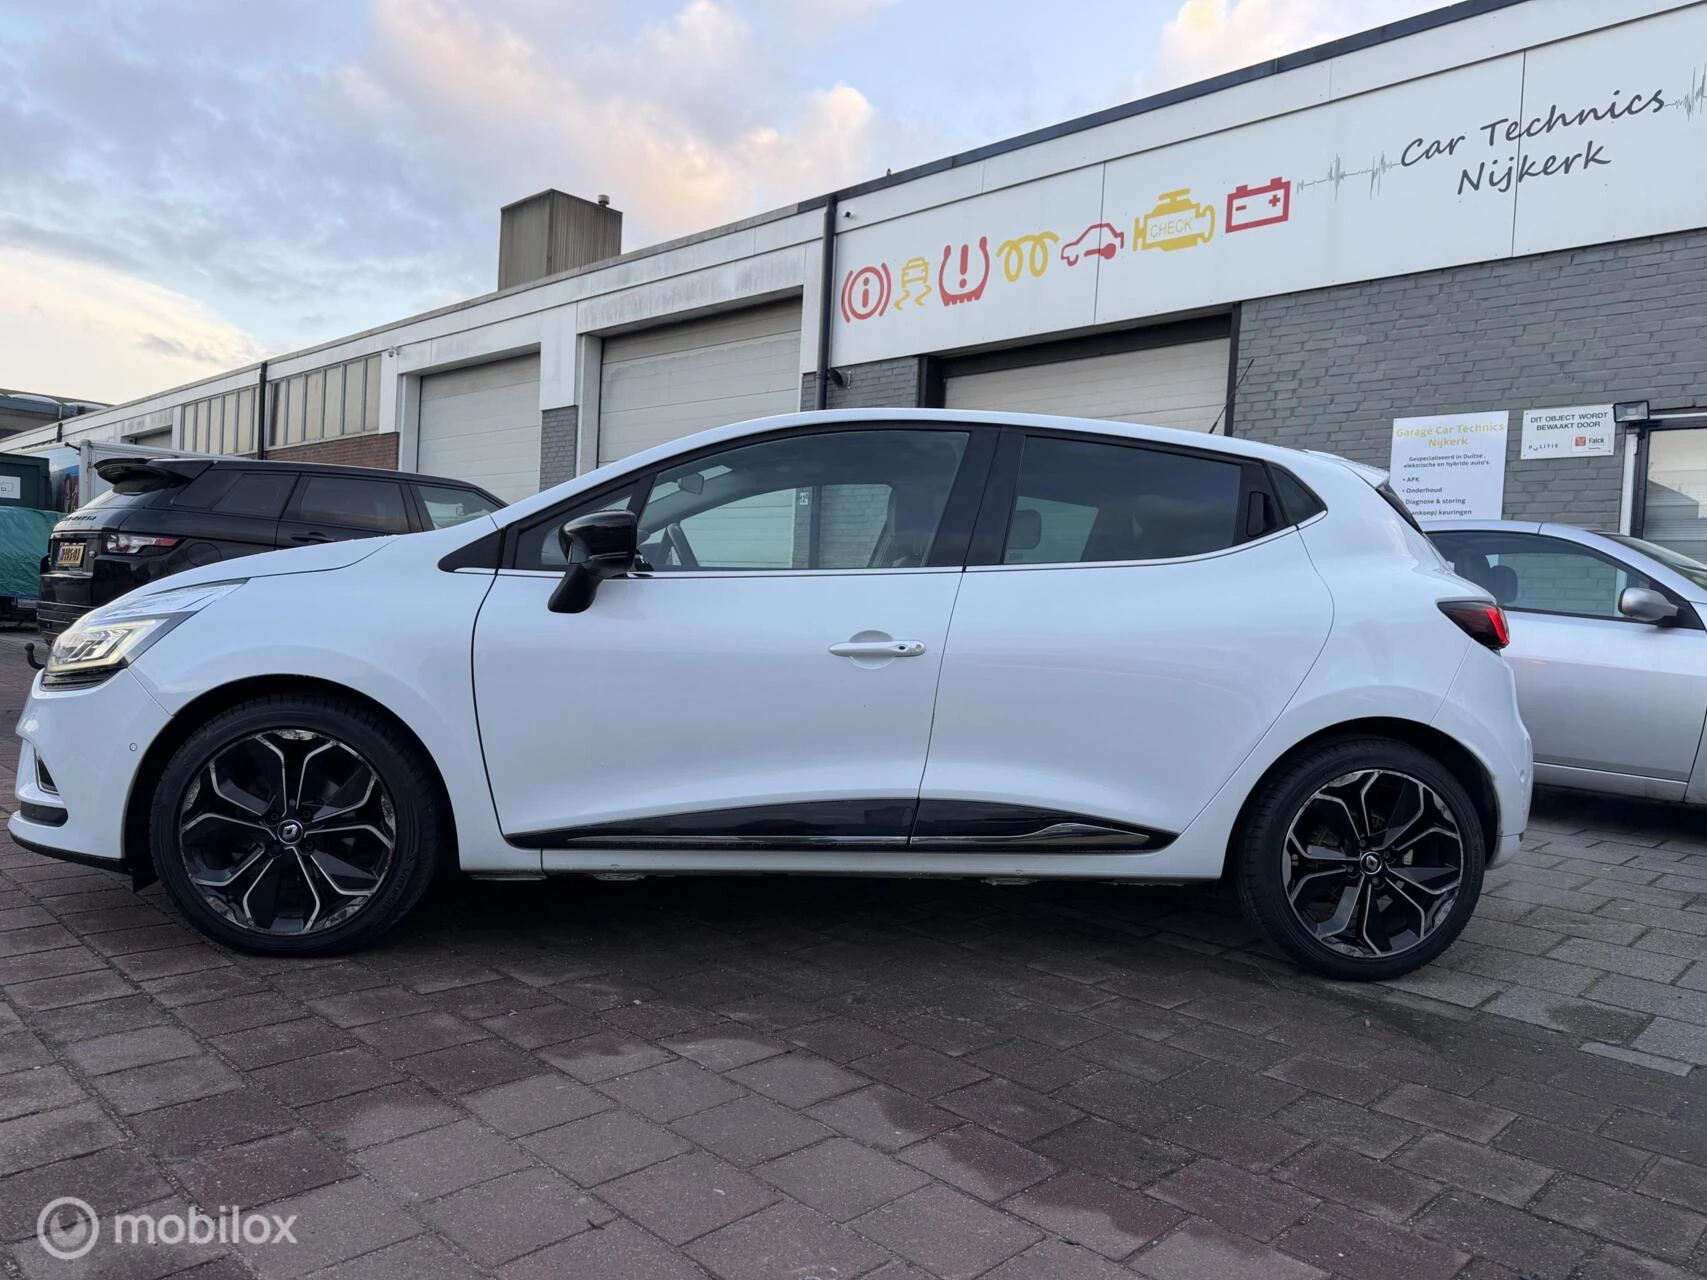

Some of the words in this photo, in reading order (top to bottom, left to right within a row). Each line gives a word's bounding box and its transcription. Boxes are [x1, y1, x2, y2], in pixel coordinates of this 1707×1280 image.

[1401, 135, 1465, 167] Car
[1480, 89, 1665, 146] Technics
[1457, 140, 1611, 195] Nijkerk
[1150, 216, 1193, 238] CHECK
[1545, 414, 1576, 422] OBJECT
[1578, 412, 1608, 420] WORDT
[1397, 427, 1433, 438] Garage
[1435, 425, 1453, 435] Car
[1456, 422, 1504, 433] Technics
[1536, 423, 1575, 431] BEWAAKT
[1576, 421, 1601, 429] DOOR
[1428, 436, 1469, 448] Nijkerk
[1446, 460, 1469, 468] hybride
